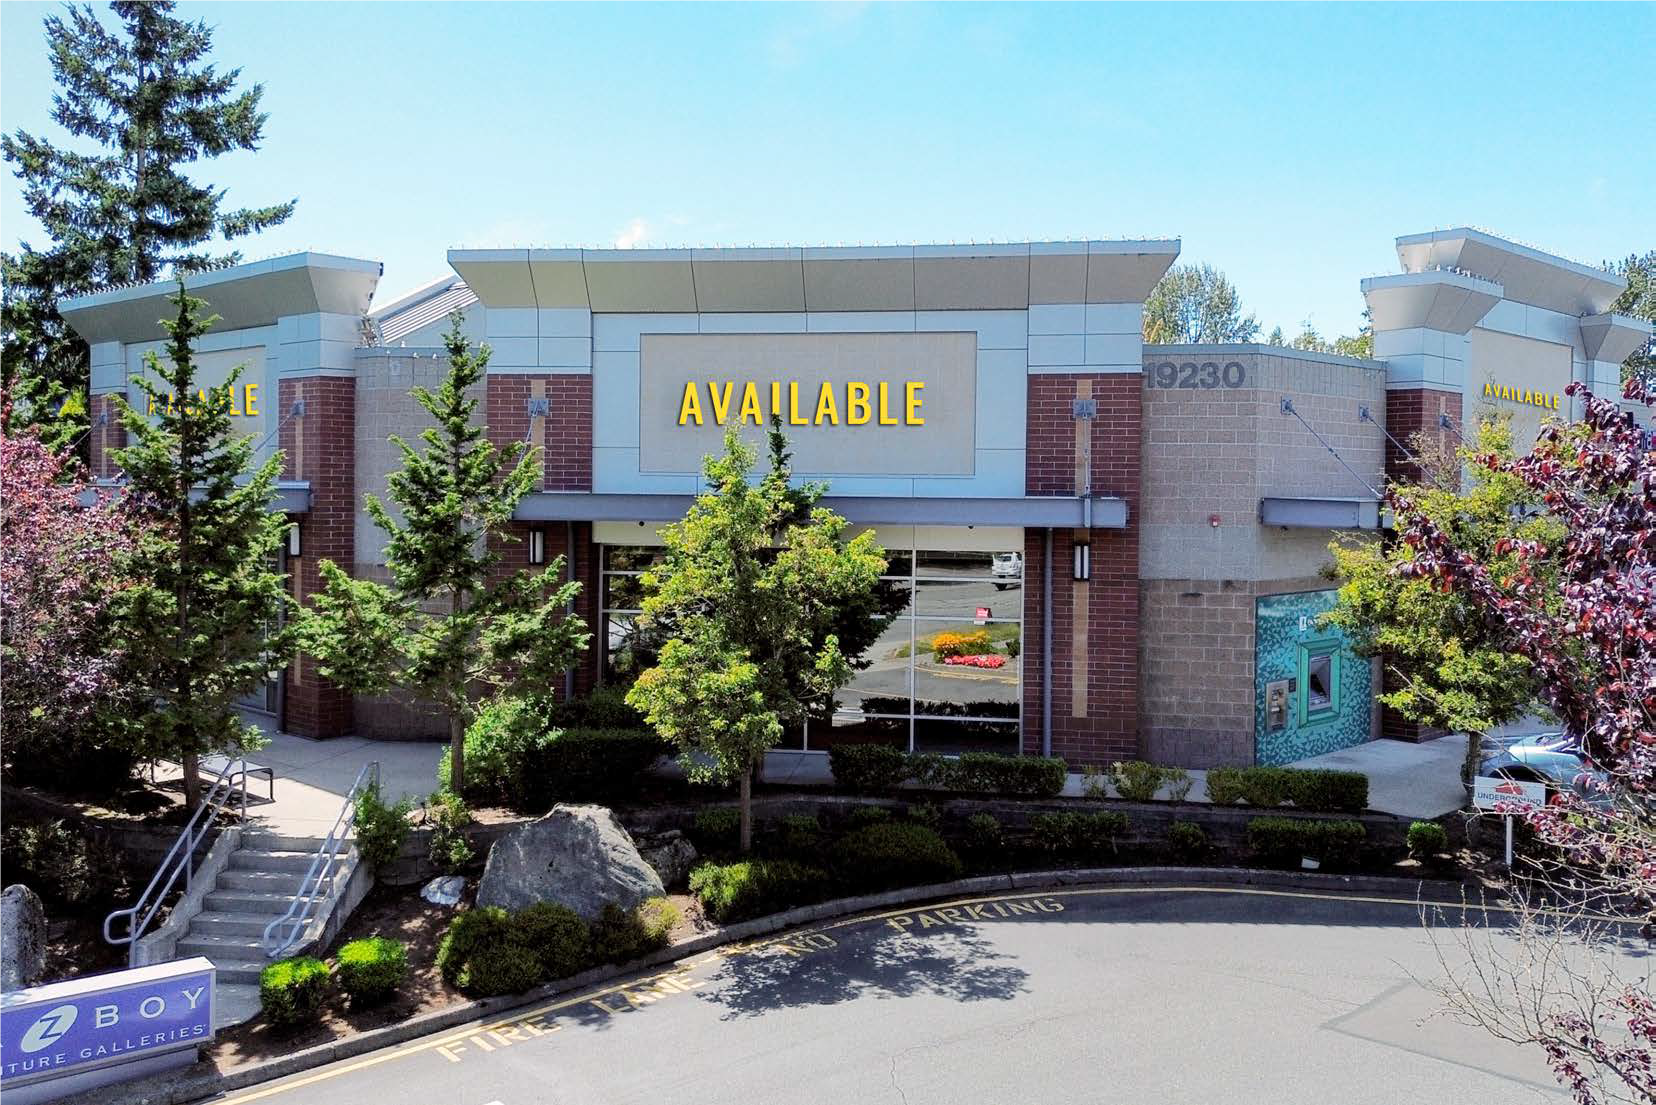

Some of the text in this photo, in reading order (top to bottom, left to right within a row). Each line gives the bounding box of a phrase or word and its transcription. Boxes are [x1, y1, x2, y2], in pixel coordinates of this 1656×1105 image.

[1146, 361, 1246, 389] 19230
[678, 381, 926, 425] AVAILABLE
[1483, 383, 1561, 410] AVAILABLE
[434, 1012, 562, 1063] FIRE
[885, 897, 1065, 934] PARKING
[80, 1024, 205, 1059] GALLERIES
